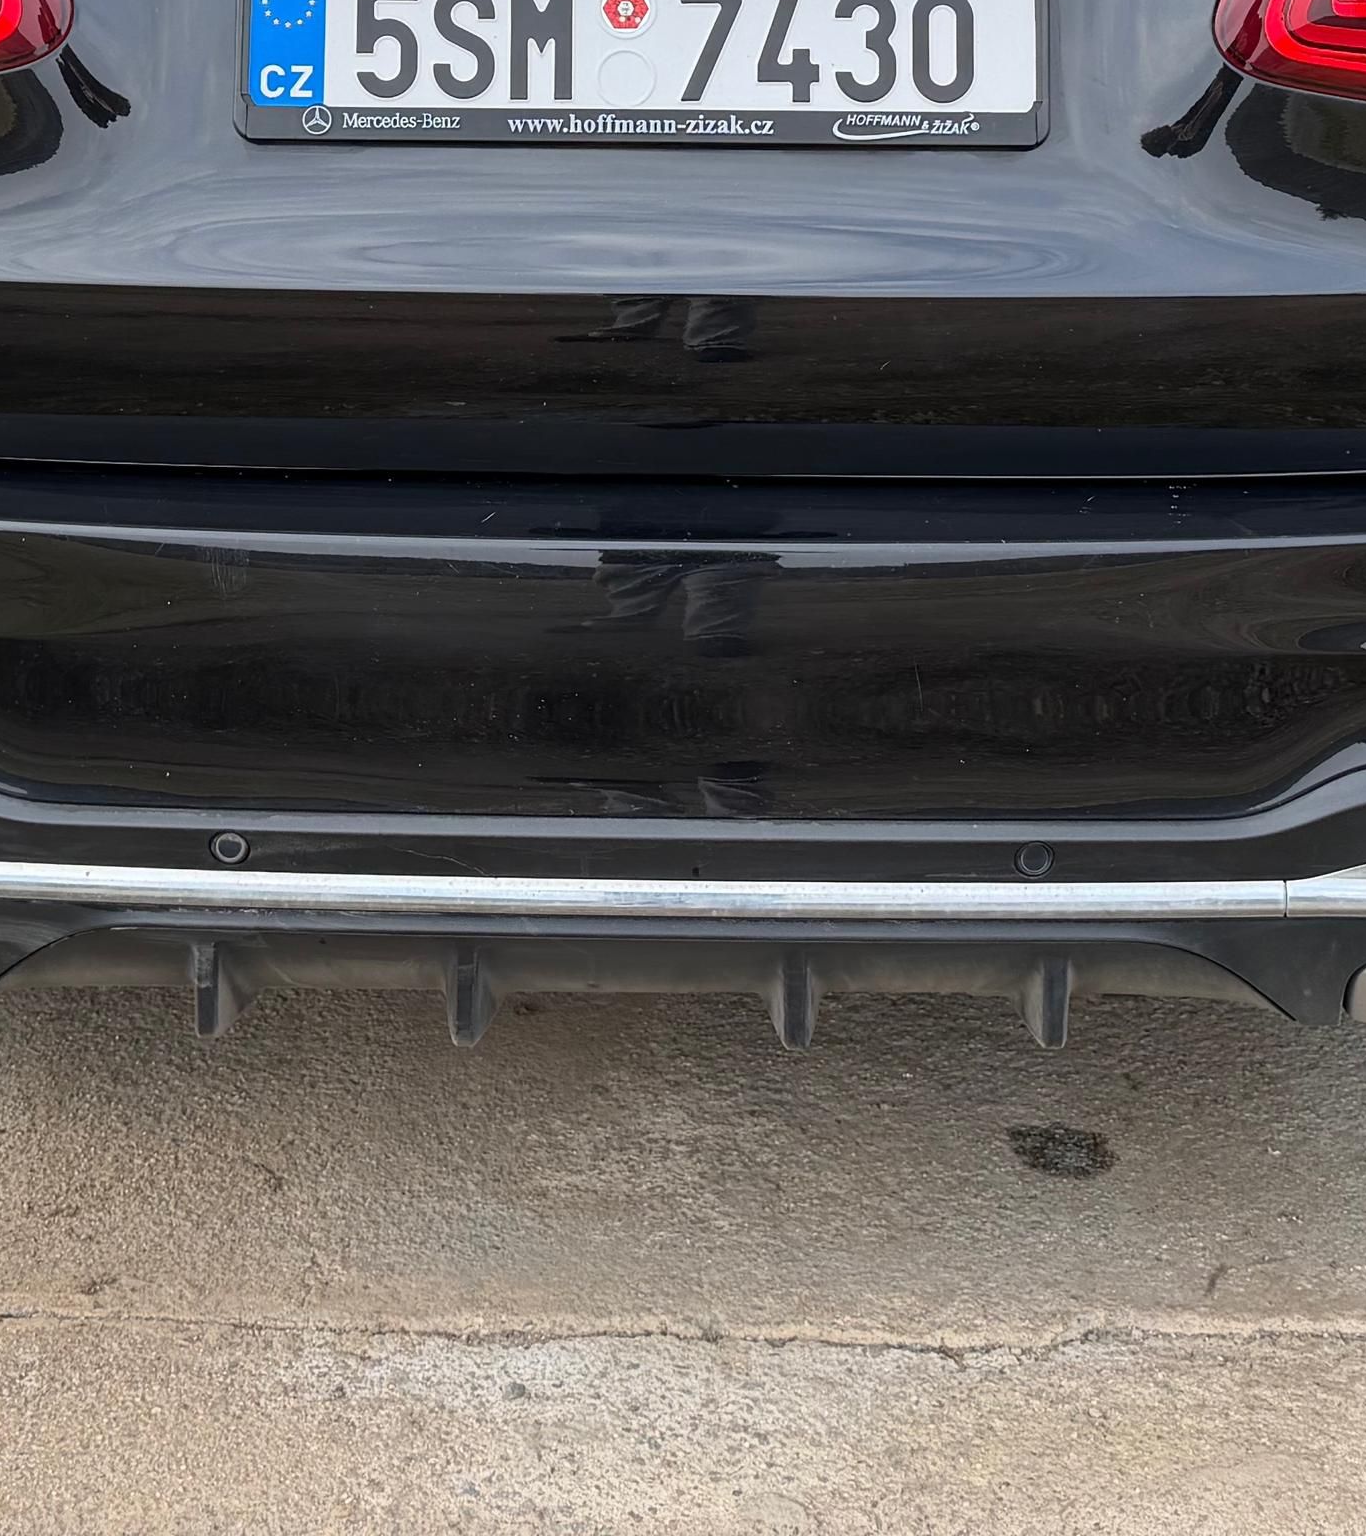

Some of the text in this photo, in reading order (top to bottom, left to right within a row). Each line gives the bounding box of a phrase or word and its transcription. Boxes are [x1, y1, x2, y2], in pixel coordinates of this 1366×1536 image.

[260, 64, 314, 98] CZ
[342, 112, 461, 129] Mercedes-Benz
[507, 114, 775, 136] www.hoffmann-zizak.cz
[846, 114, 922, 126] HOFFMANN
[922, 120, 930, 130] &
